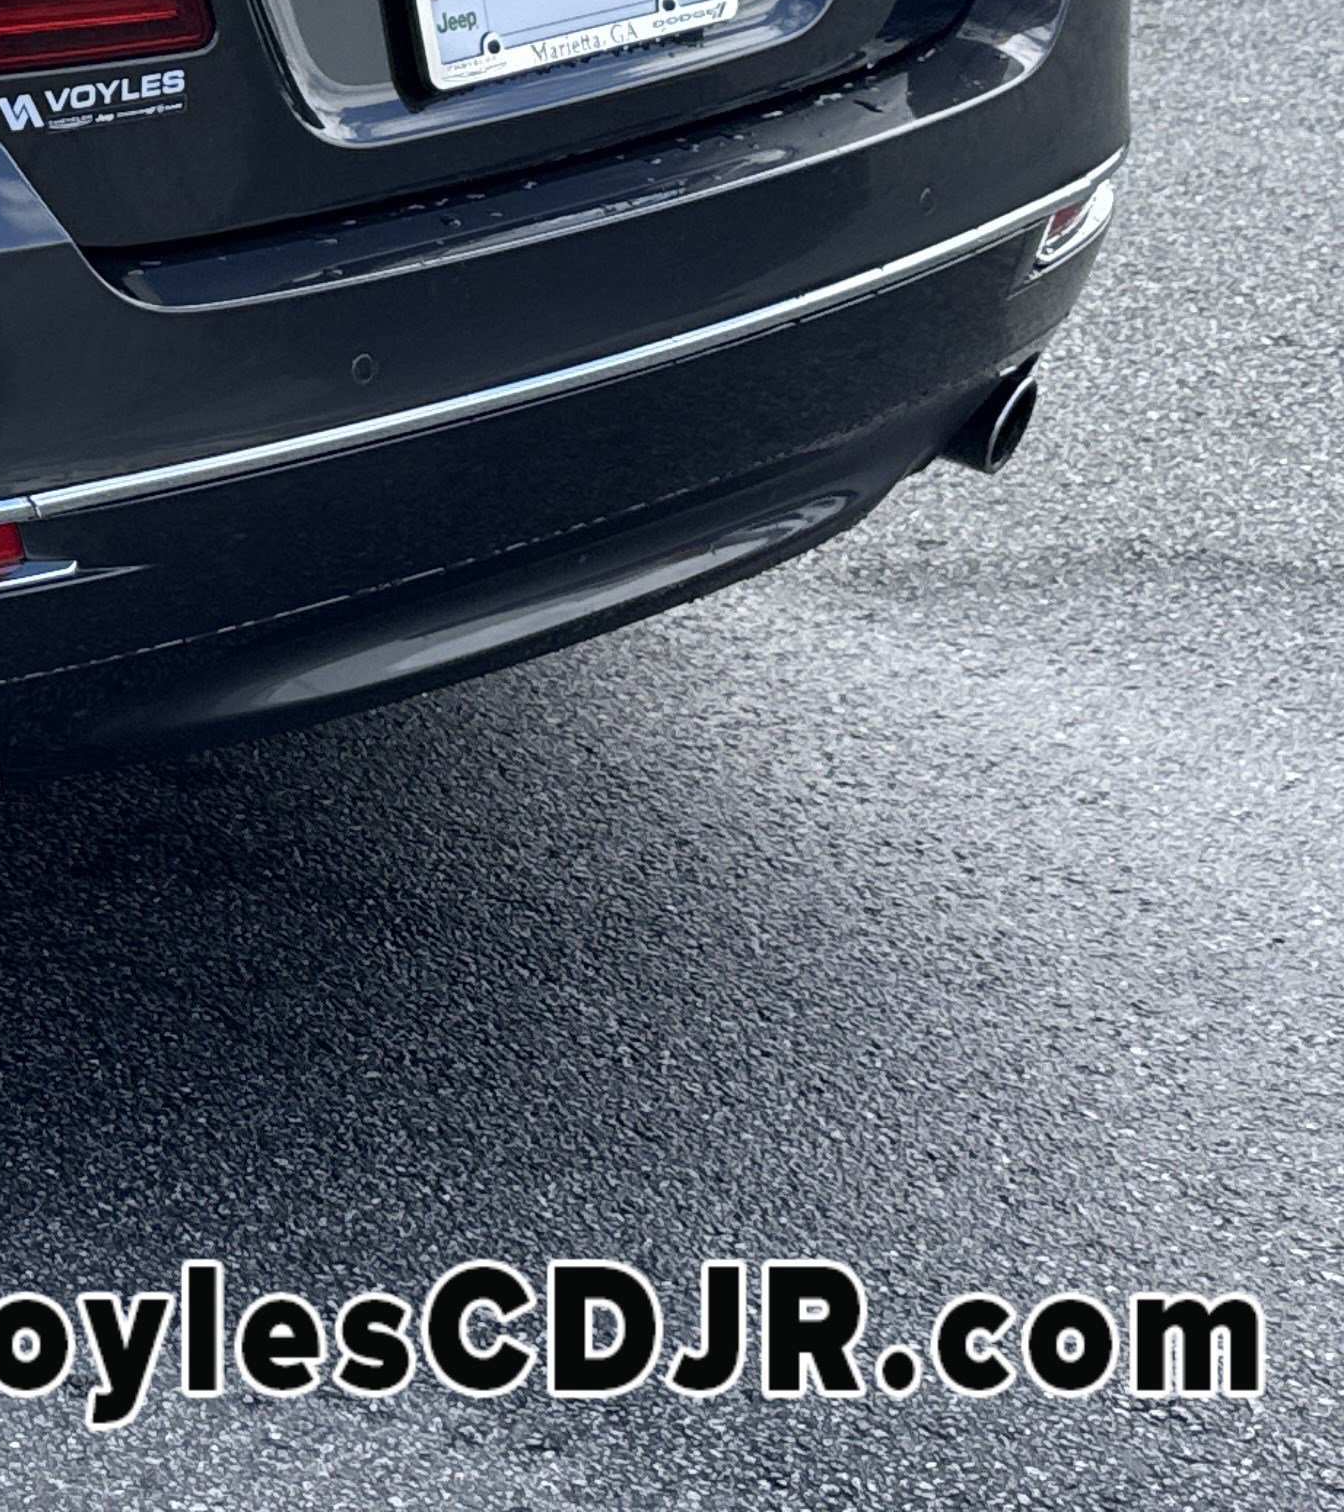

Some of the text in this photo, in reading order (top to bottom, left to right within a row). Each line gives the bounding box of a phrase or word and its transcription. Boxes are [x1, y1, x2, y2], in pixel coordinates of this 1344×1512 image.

[436, 11, 477, 33] Jeep
[610, 22, 639, 44] GA
[44, 69, 186, 112] VOYLES
